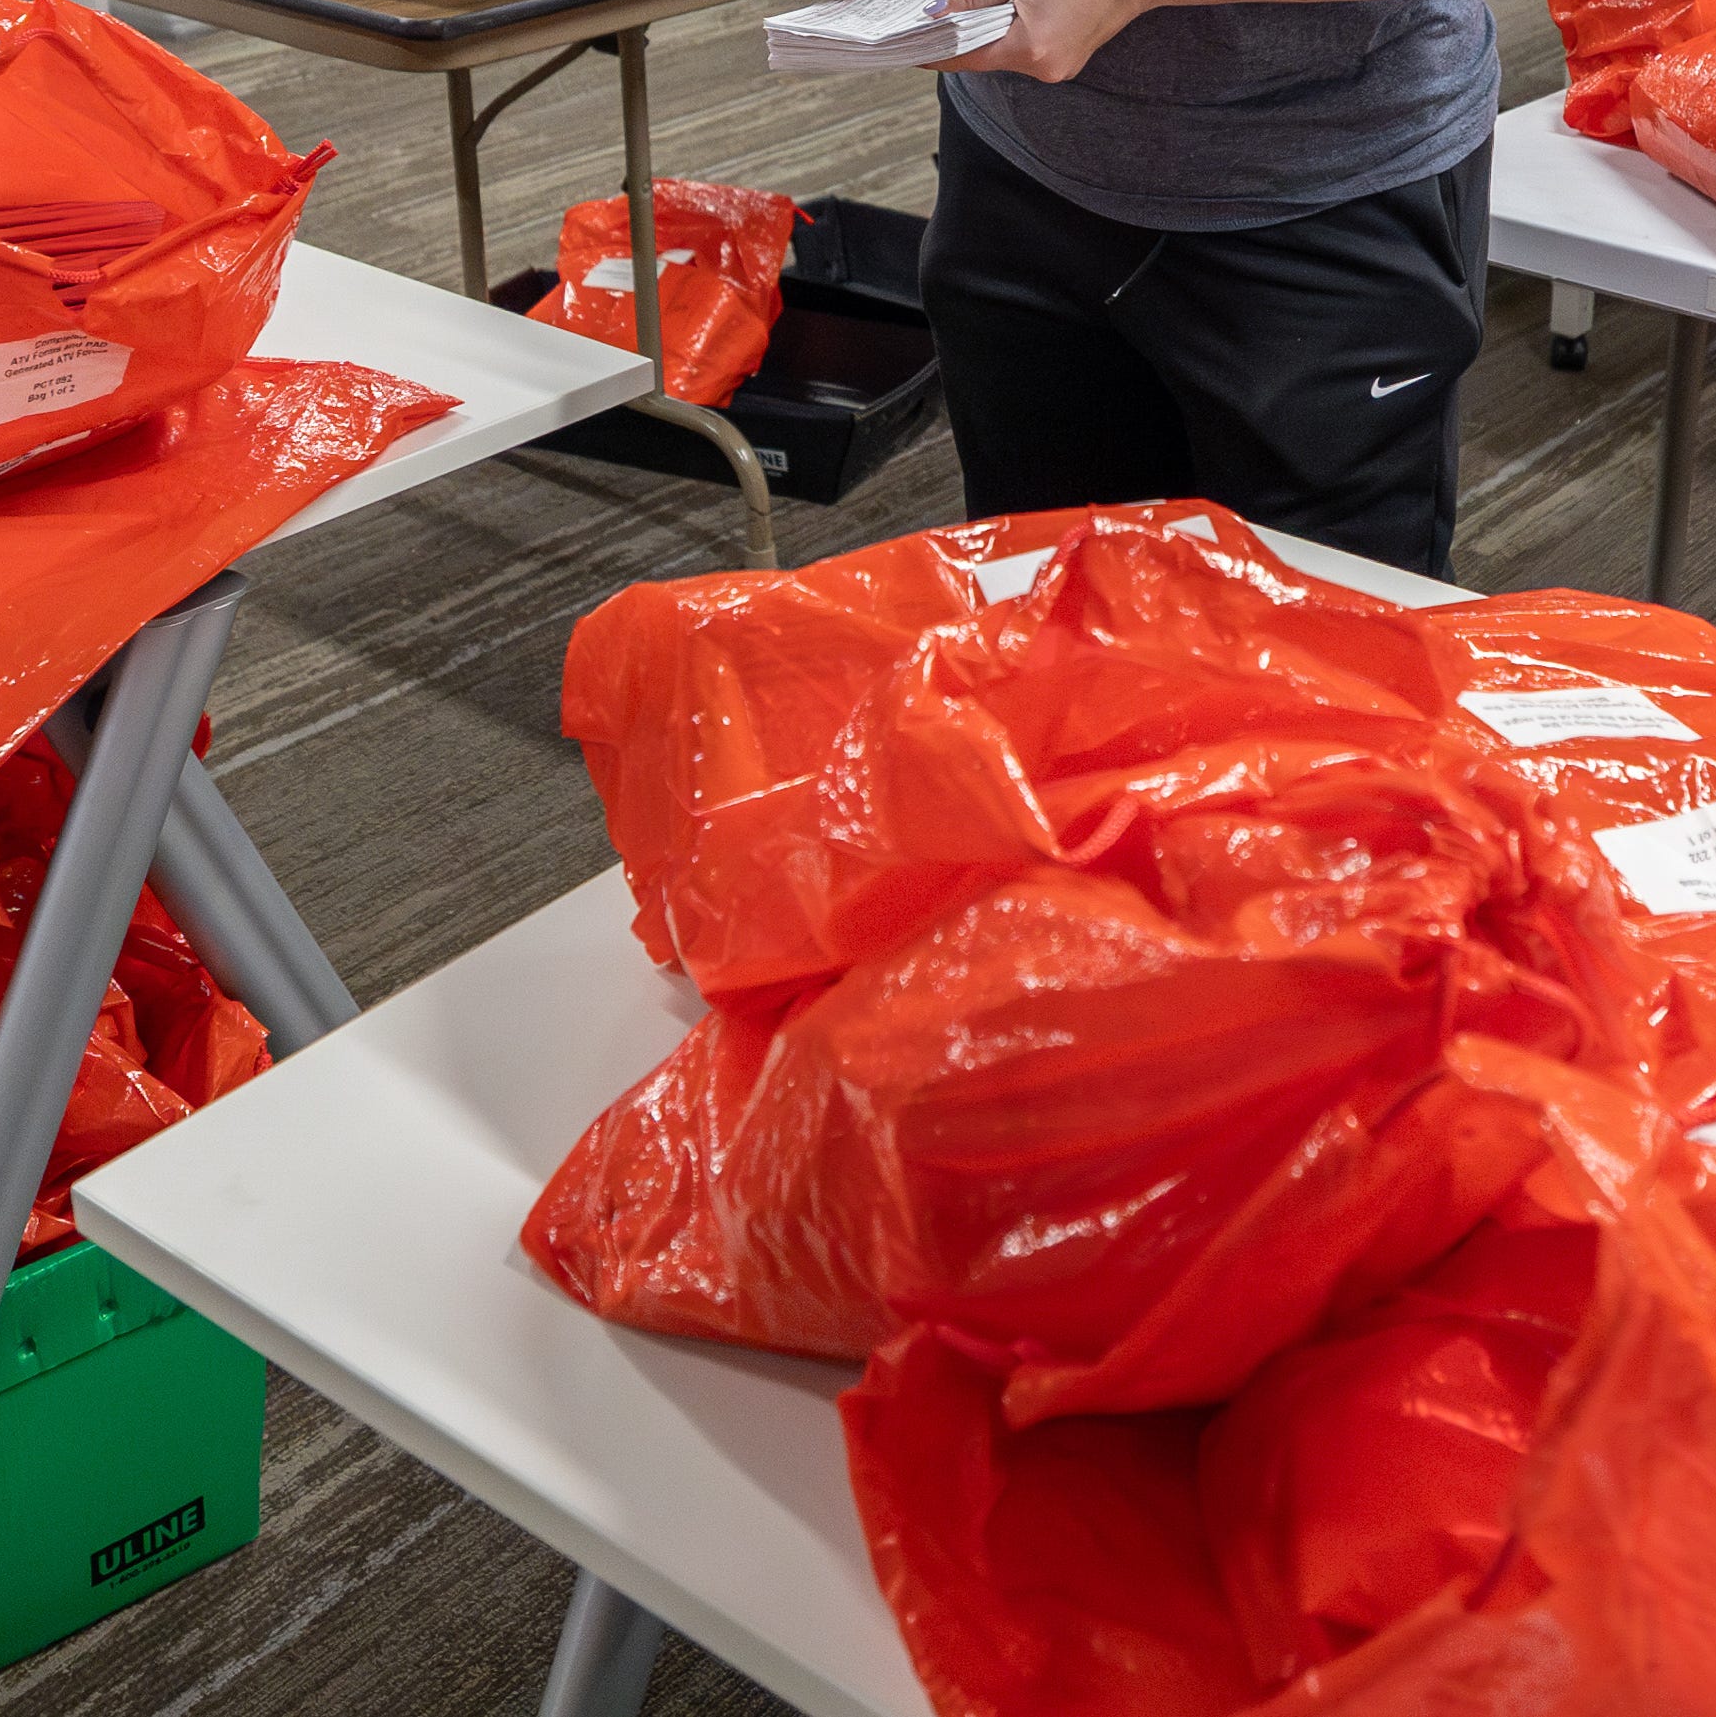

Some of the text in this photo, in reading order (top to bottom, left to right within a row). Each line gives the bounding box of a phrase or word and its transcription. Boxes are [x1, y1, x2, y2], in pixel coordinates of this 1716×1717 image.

[10, 355, 30, 366] ATV
[32, 346, 62, 360] Forms
[64, 342, 83, 351] and
[4, 358, 54, 378] Generated
[56, 352, 75, 364] ATV
[33, 378, 52, 390] PCT
[28, 392, 47, 403] Bag
[57, 386, 67, 395] of
[69, 385, 75, 393] 2
[1688, 836, 1696, 847] 1
[1699, 831, 1711, 845] of
[98, 1505, 197, 1576] ULINE
